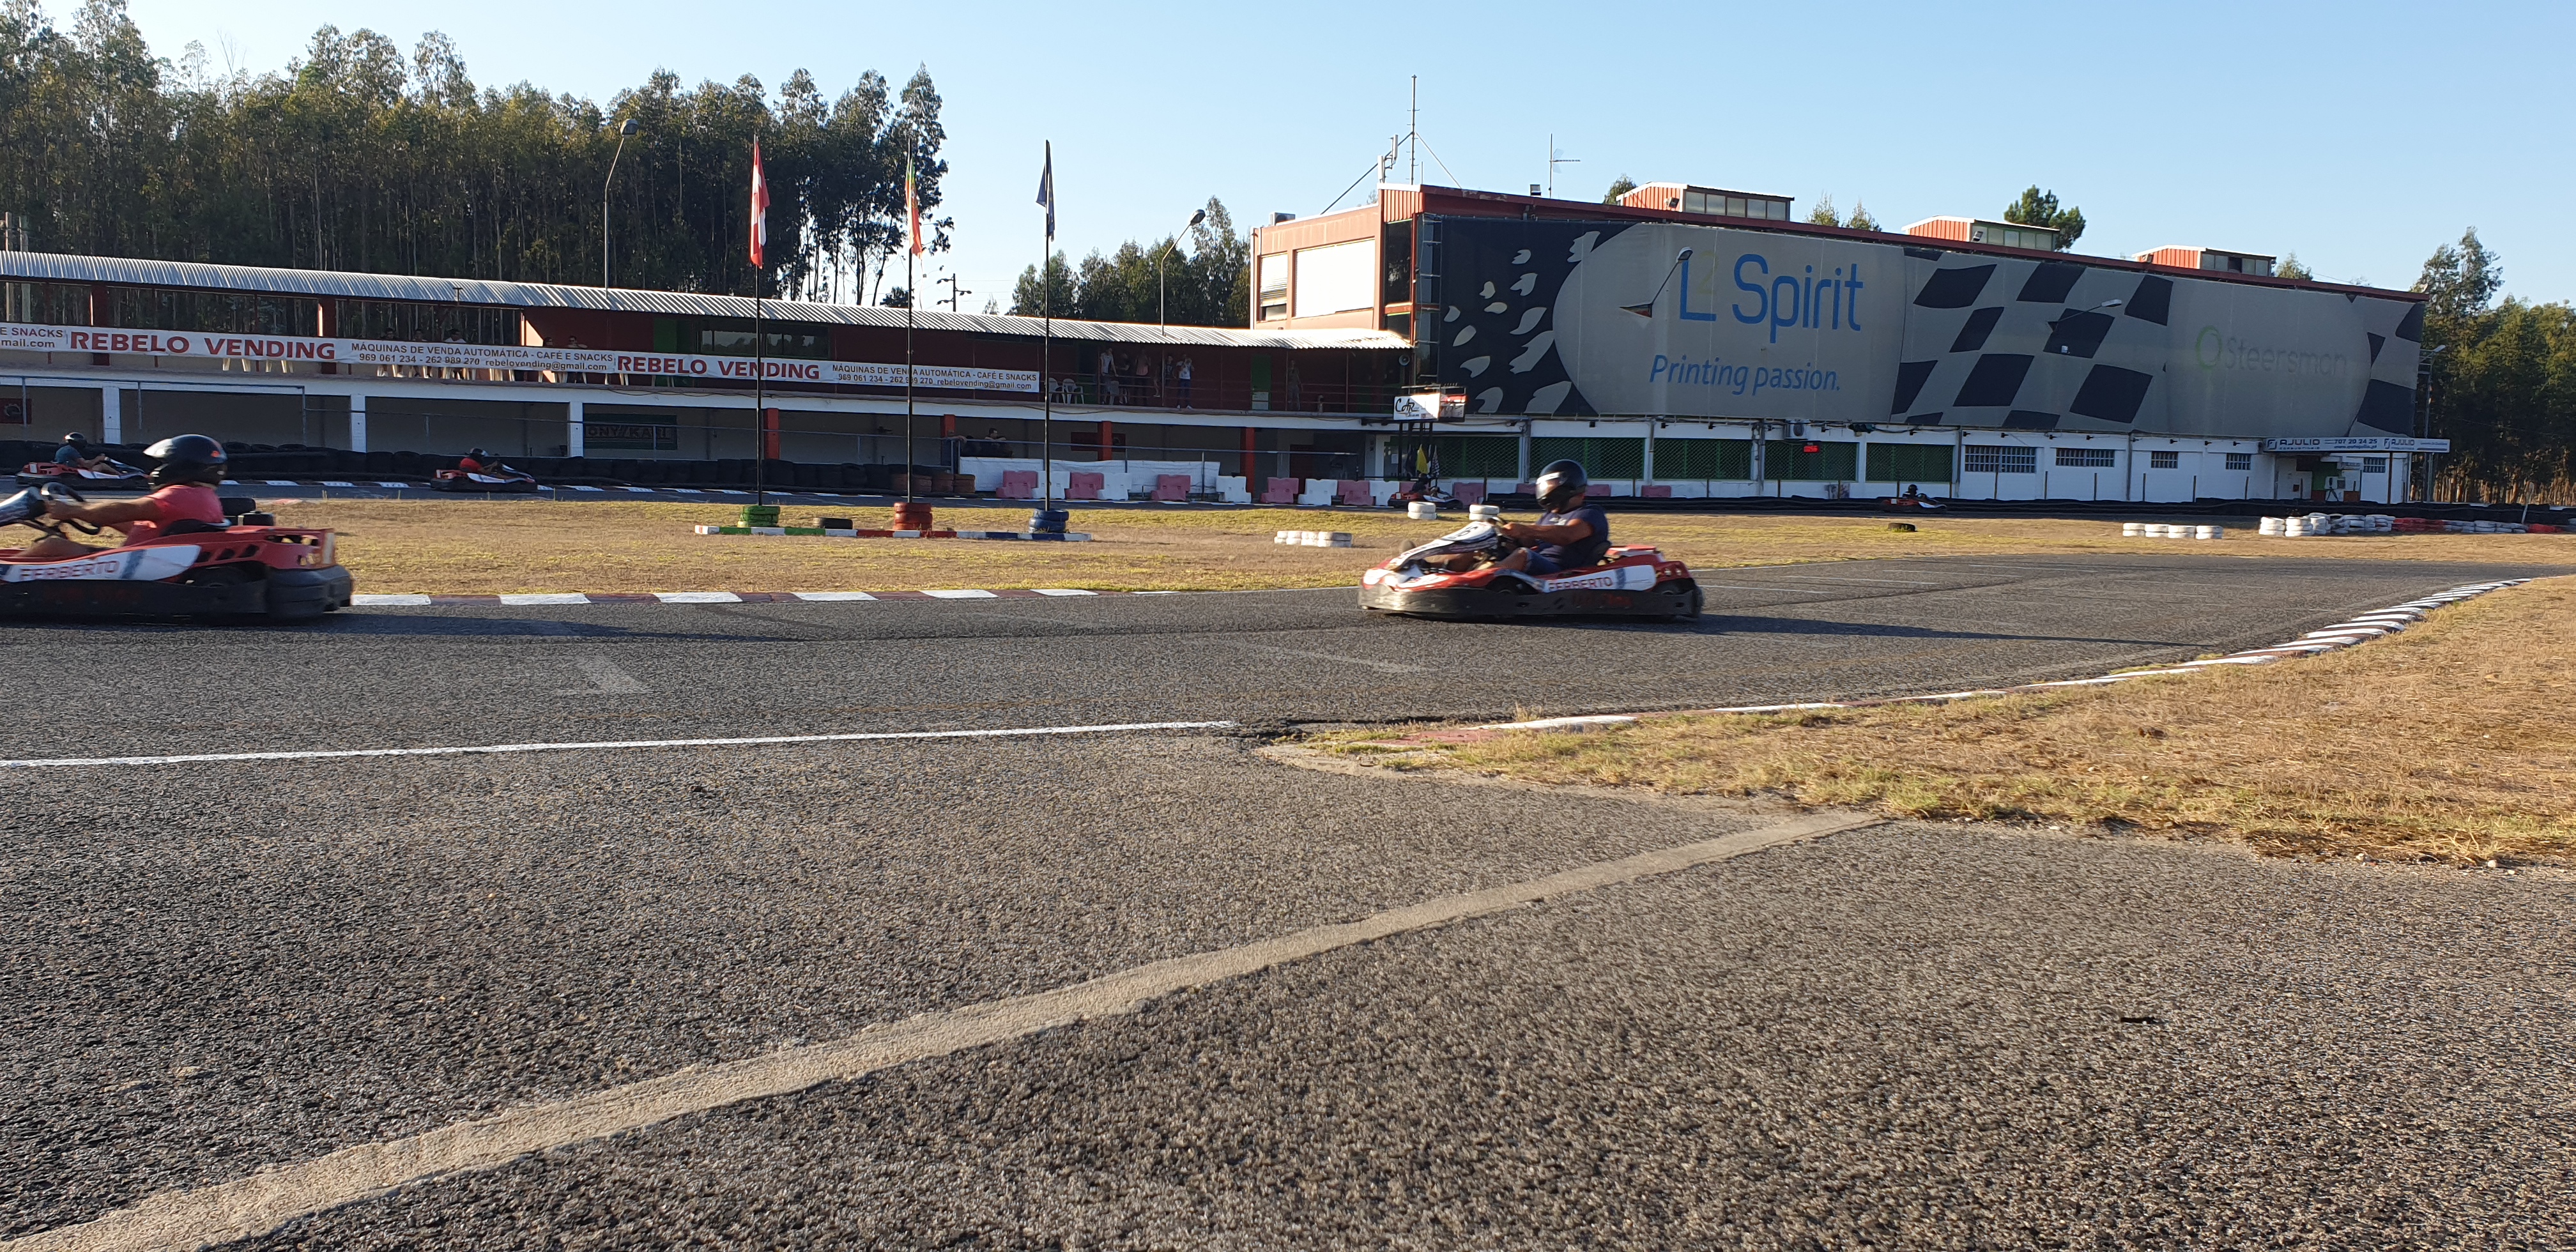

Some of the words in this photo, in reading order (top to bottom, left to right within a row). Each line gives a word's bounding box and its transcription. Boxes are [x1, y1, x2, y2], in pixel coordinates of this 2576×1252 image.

[1731, 254, 1864, 344] Spirit
[12, 327, 63, 338] SNACKS
[71, 331, 190, 353] REBELO
[204, 337, 335, 360] VENDING
[351, 342, 407, 353] MÁQUINAS
[411, 346, 424, 354] DE
[427, 346, 462, 355] VENDA
[463, 347, 529, 358] AUTOMÁTICA
[537, 351, 562, 360] CAFÉ
[574, 353, 613, 362] SNACKS
[359, 353, 376, 362] 969
[379, 354, 395, 362] 061
[486, 359, 608, 370] rebelovending@gmail.com
[618, 356, 707, 374] REBELO
[718, 360, 820, 379] VENDING
[832, 363, 875, 374] MÁQUINAS
[919, 369, 971, 379] AUTOMÁTICA
[977, 371, 997, 379] CAFÉ
[937, 379, 1032, 389] rebelovending@gmail.com
[1650, 354, 1749, 395] Printing
[1752, 362, 1841, 396] passion.
